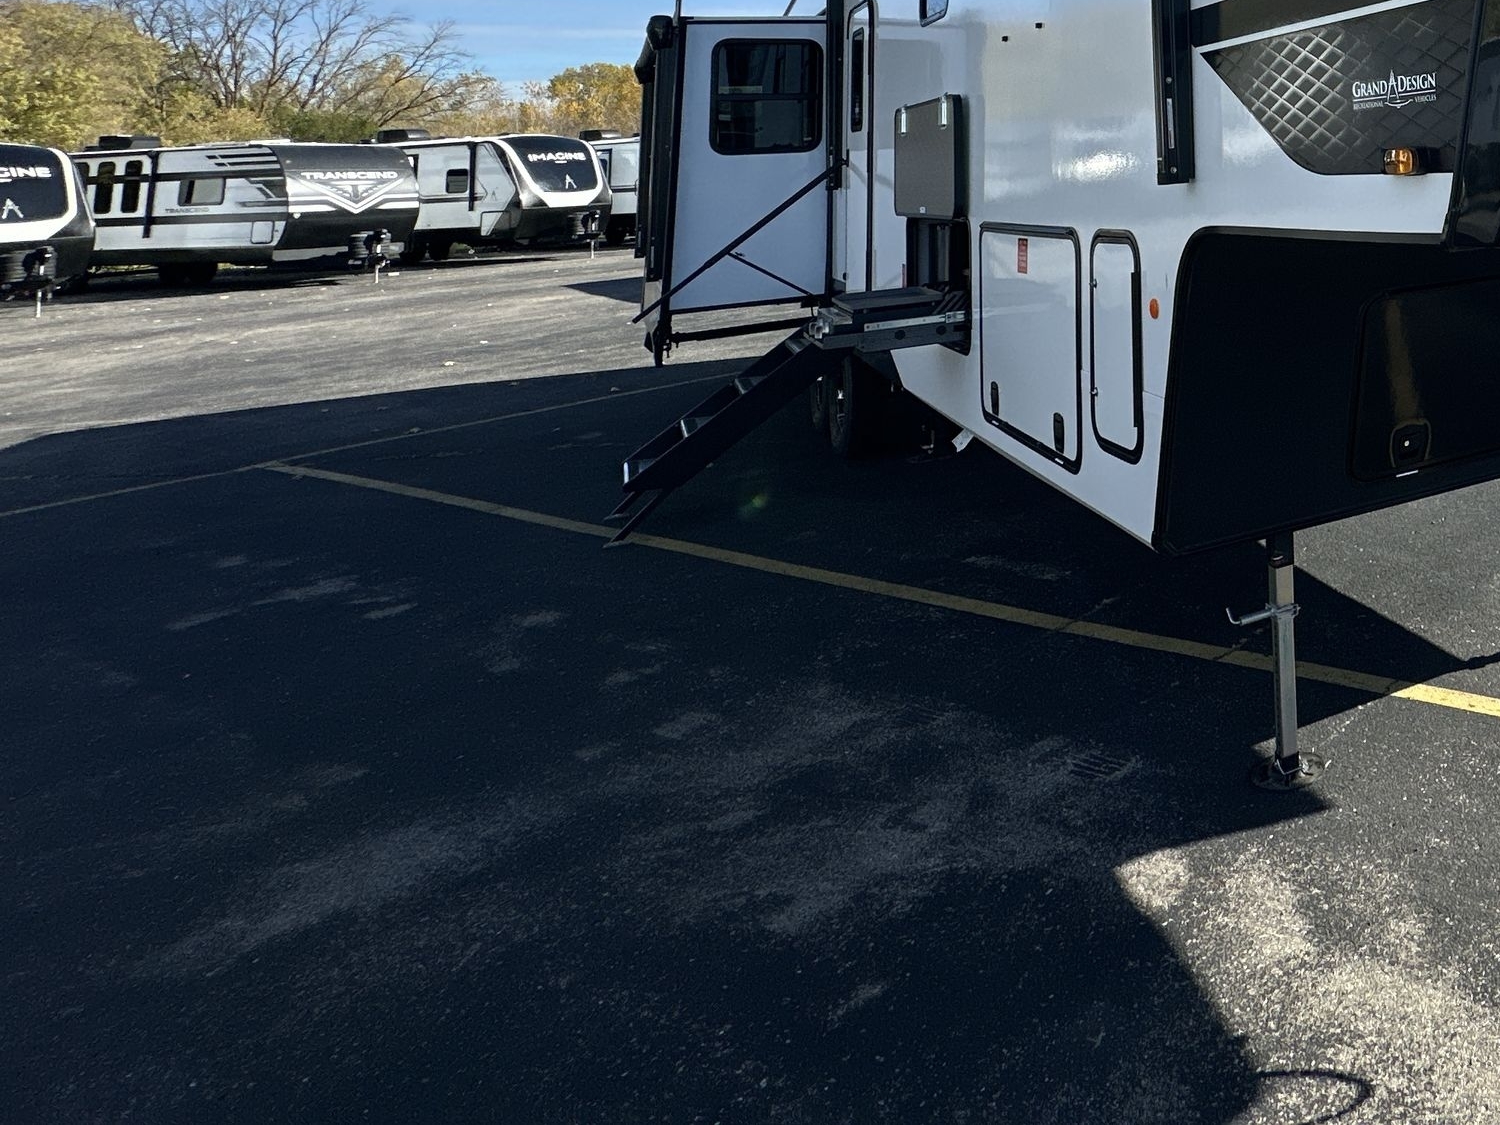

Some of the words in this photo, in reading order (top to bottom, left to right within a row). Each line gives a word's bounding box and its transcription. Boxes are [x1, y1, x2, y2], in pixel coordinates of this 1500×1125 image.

[1352, 80, 1388, 97] GRAND
[1397, 72, 1437, 92] DESIGN
[527, 151, 587, 162] IMAGINE
[300, 171, 398, 180] TRANSCEND
